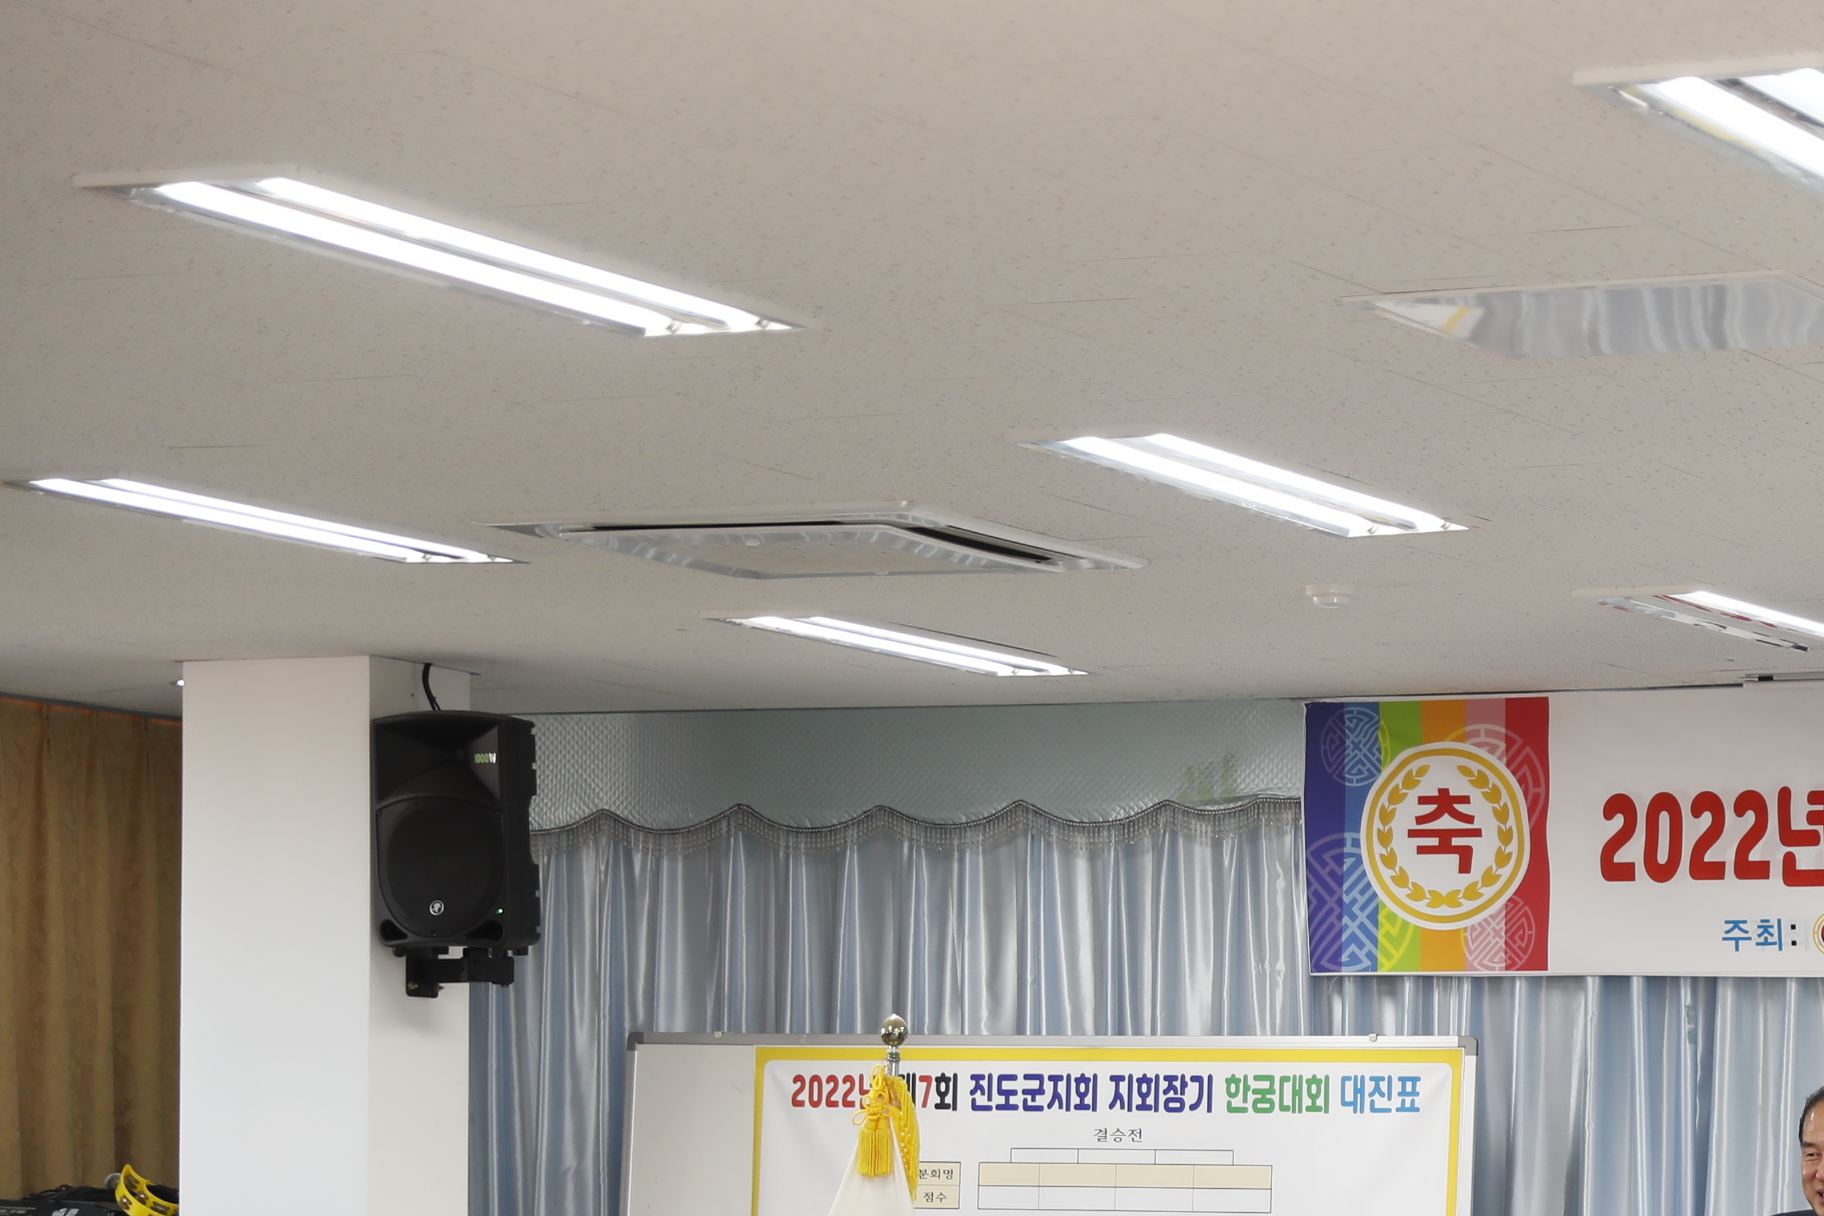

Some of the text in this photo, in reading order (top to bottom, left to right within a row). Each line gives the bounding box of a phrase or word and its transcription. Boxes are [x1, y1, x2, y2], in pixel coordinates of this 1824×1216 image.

[1407, 786, 1483, 875] 축
[968, 1072, 1099, 1113] 진도군지회
[1108, 1072, 1214, 1114] 지회장기
[1224, 1073, 1330, 1115] 한궁대회
[1340, 1074, 1422, 1115] 대진표
[1093, 1127, 1143, 1143] 결승전
[918, 1168, 954, 1180] 분회명
[923, 1191, 948, 1203] 점수
